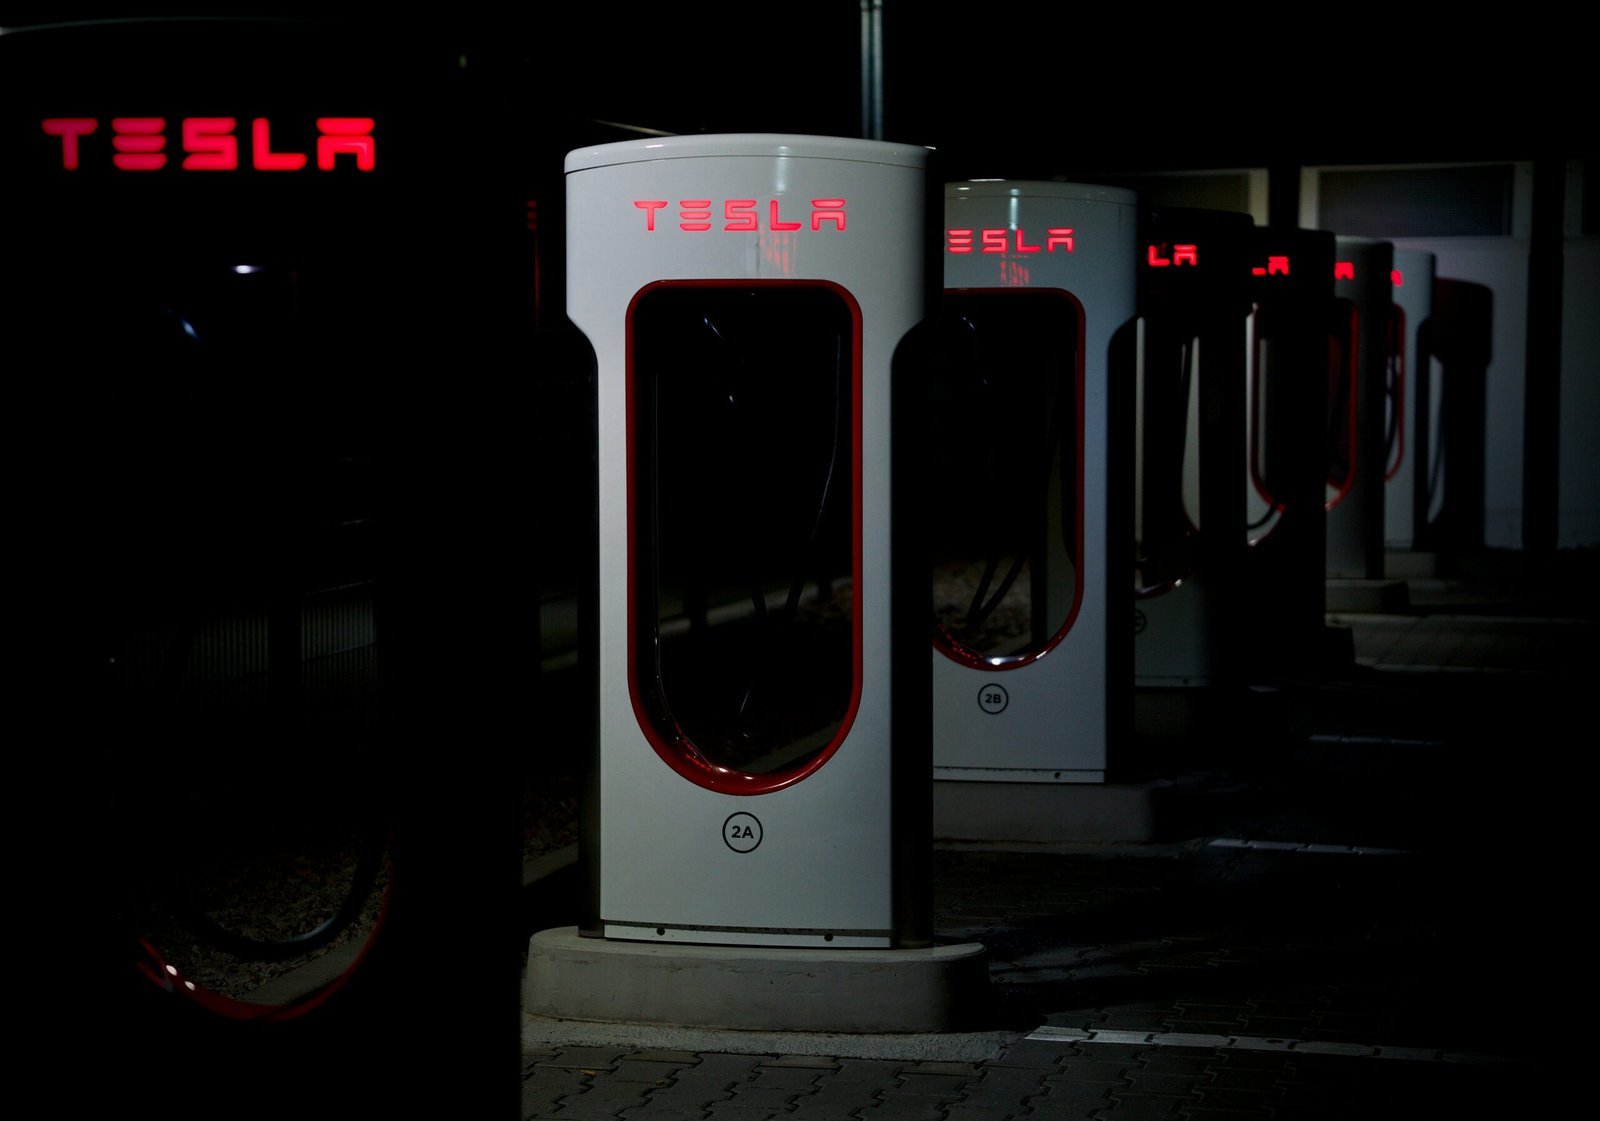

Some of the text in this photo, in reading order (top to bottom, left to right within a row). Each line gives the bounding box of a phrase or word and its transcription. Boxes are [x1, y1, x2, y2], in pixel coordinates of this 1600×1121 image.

[42, 116, 376, 172] TESLA
[634, 199, 847, 231] TESLA
[985, 693, 1002, 704] 2B
[731, 825, 754, 839] 2A
